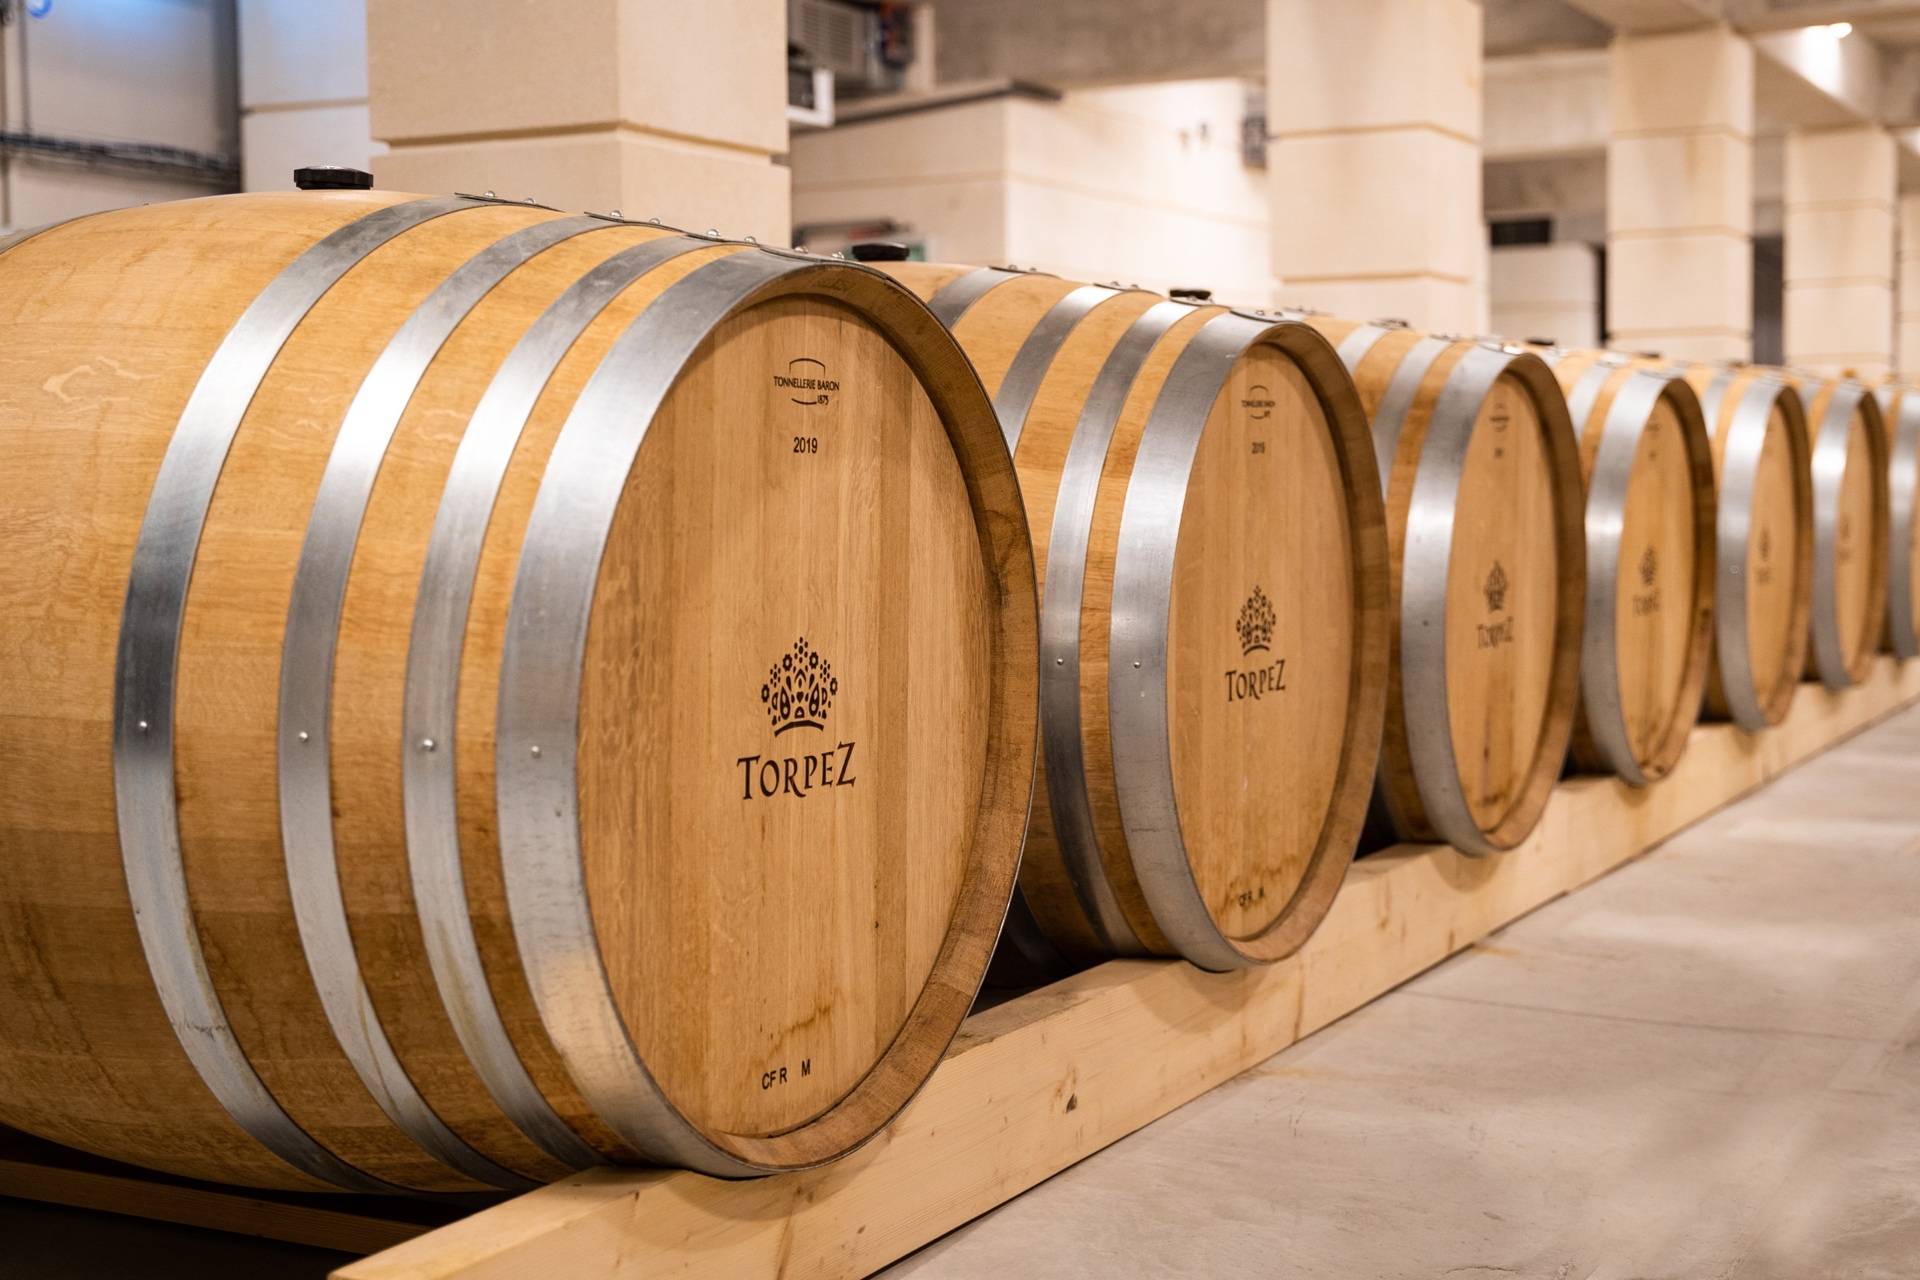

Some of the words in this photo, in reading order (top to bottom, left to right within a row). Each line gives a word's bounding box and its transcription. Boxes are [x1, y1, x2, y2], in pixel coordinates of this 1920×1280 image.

[773, 375, 816, 390] TONNELLERIE
[817, 380, 840, 391] BARON
[793, 436, 818, 454] 2019
[1225, 659, 1286, 702] TORPEZ
[736, 741, 857, 801] TORPEZ
[801, 1058, 811, 1078] M
